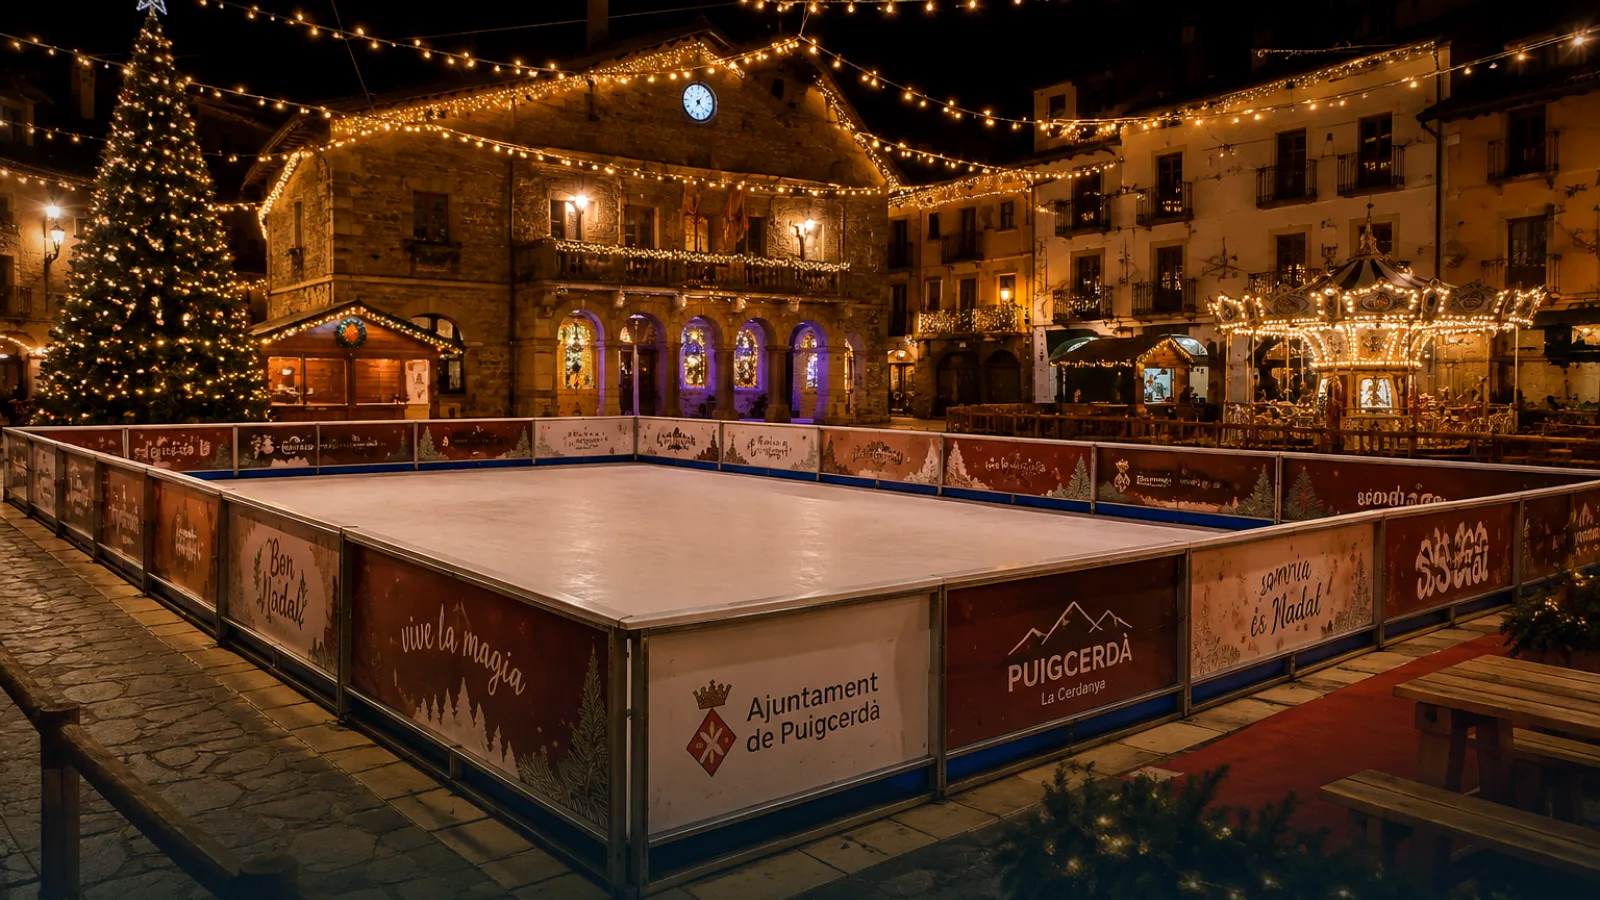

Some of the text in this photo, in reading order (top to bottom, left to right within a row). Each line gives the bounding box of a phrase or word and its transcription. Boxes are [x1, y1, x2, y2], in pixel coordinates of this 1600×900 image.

[271, 538, 295, 580] Bon
[260, 571, 301, 623] Nadal
[1271, 582, 1322, 635] Nadal
[401, 602, 526, 695] vive la magia
[1008, 632, 1133, 692] PUIGCERDÀ
[746, 672, 879, 723] Ajuntament
[1041, 679, 1106, 706] La Cerdanya
[746, 699, 880, 753] de Puigcerdà
